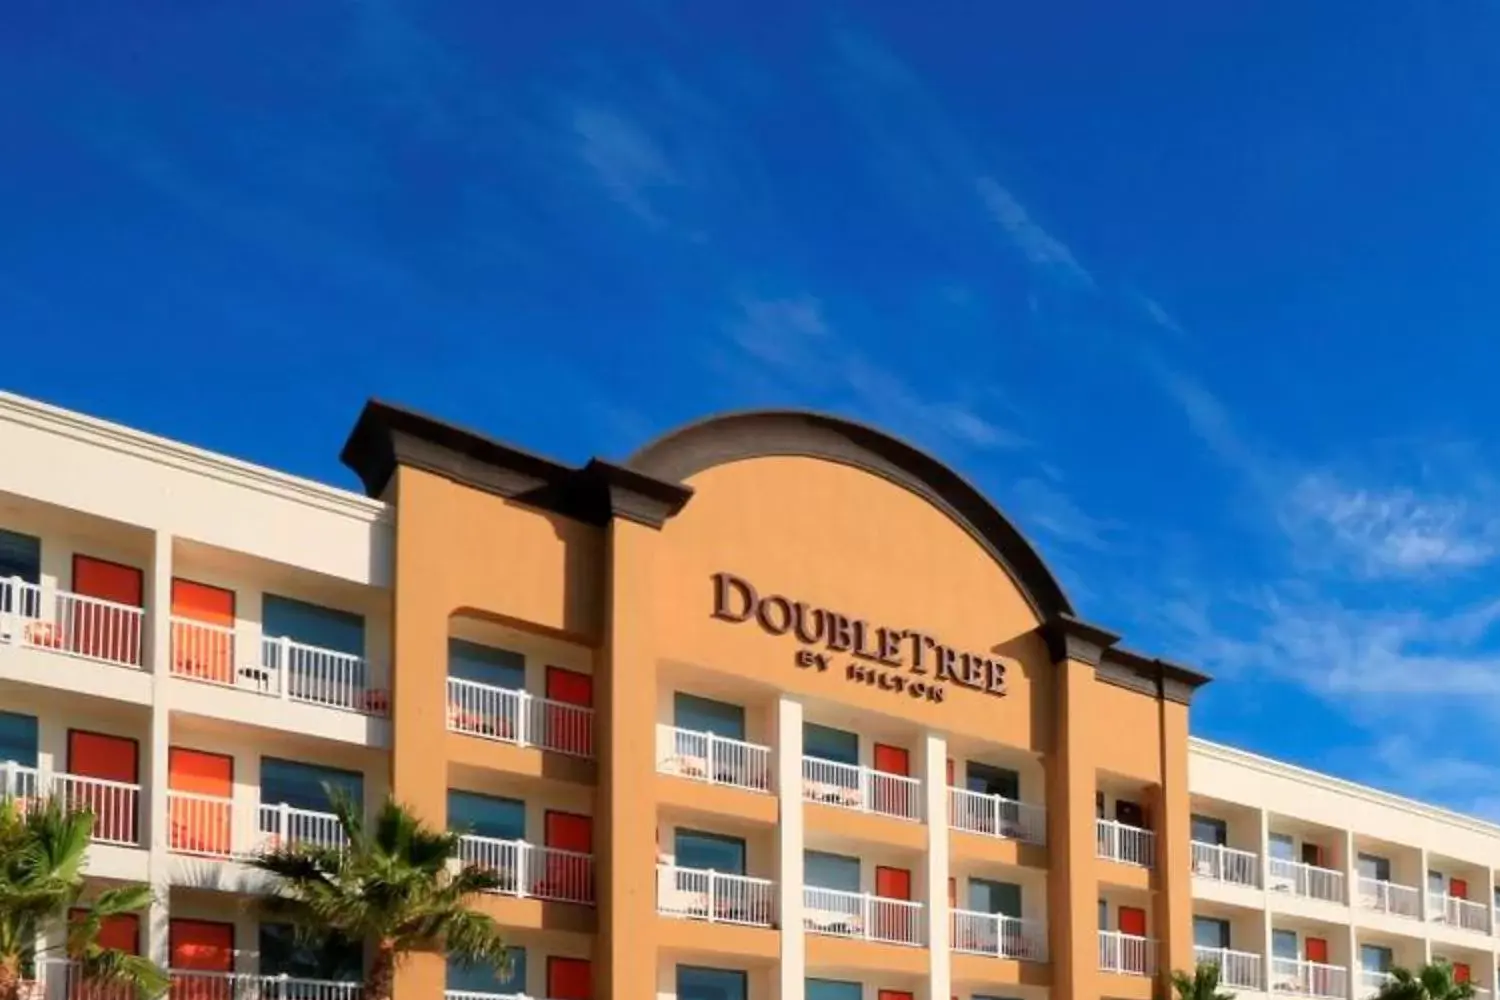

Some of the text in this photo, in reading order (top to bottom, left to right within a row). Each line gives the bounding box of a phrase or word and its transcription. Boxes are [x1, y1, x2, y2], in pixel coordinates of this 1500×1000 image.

[709, 572, 1007, 697] DOUBLETREE
[795, 650, 944, 704] BY HILTON
